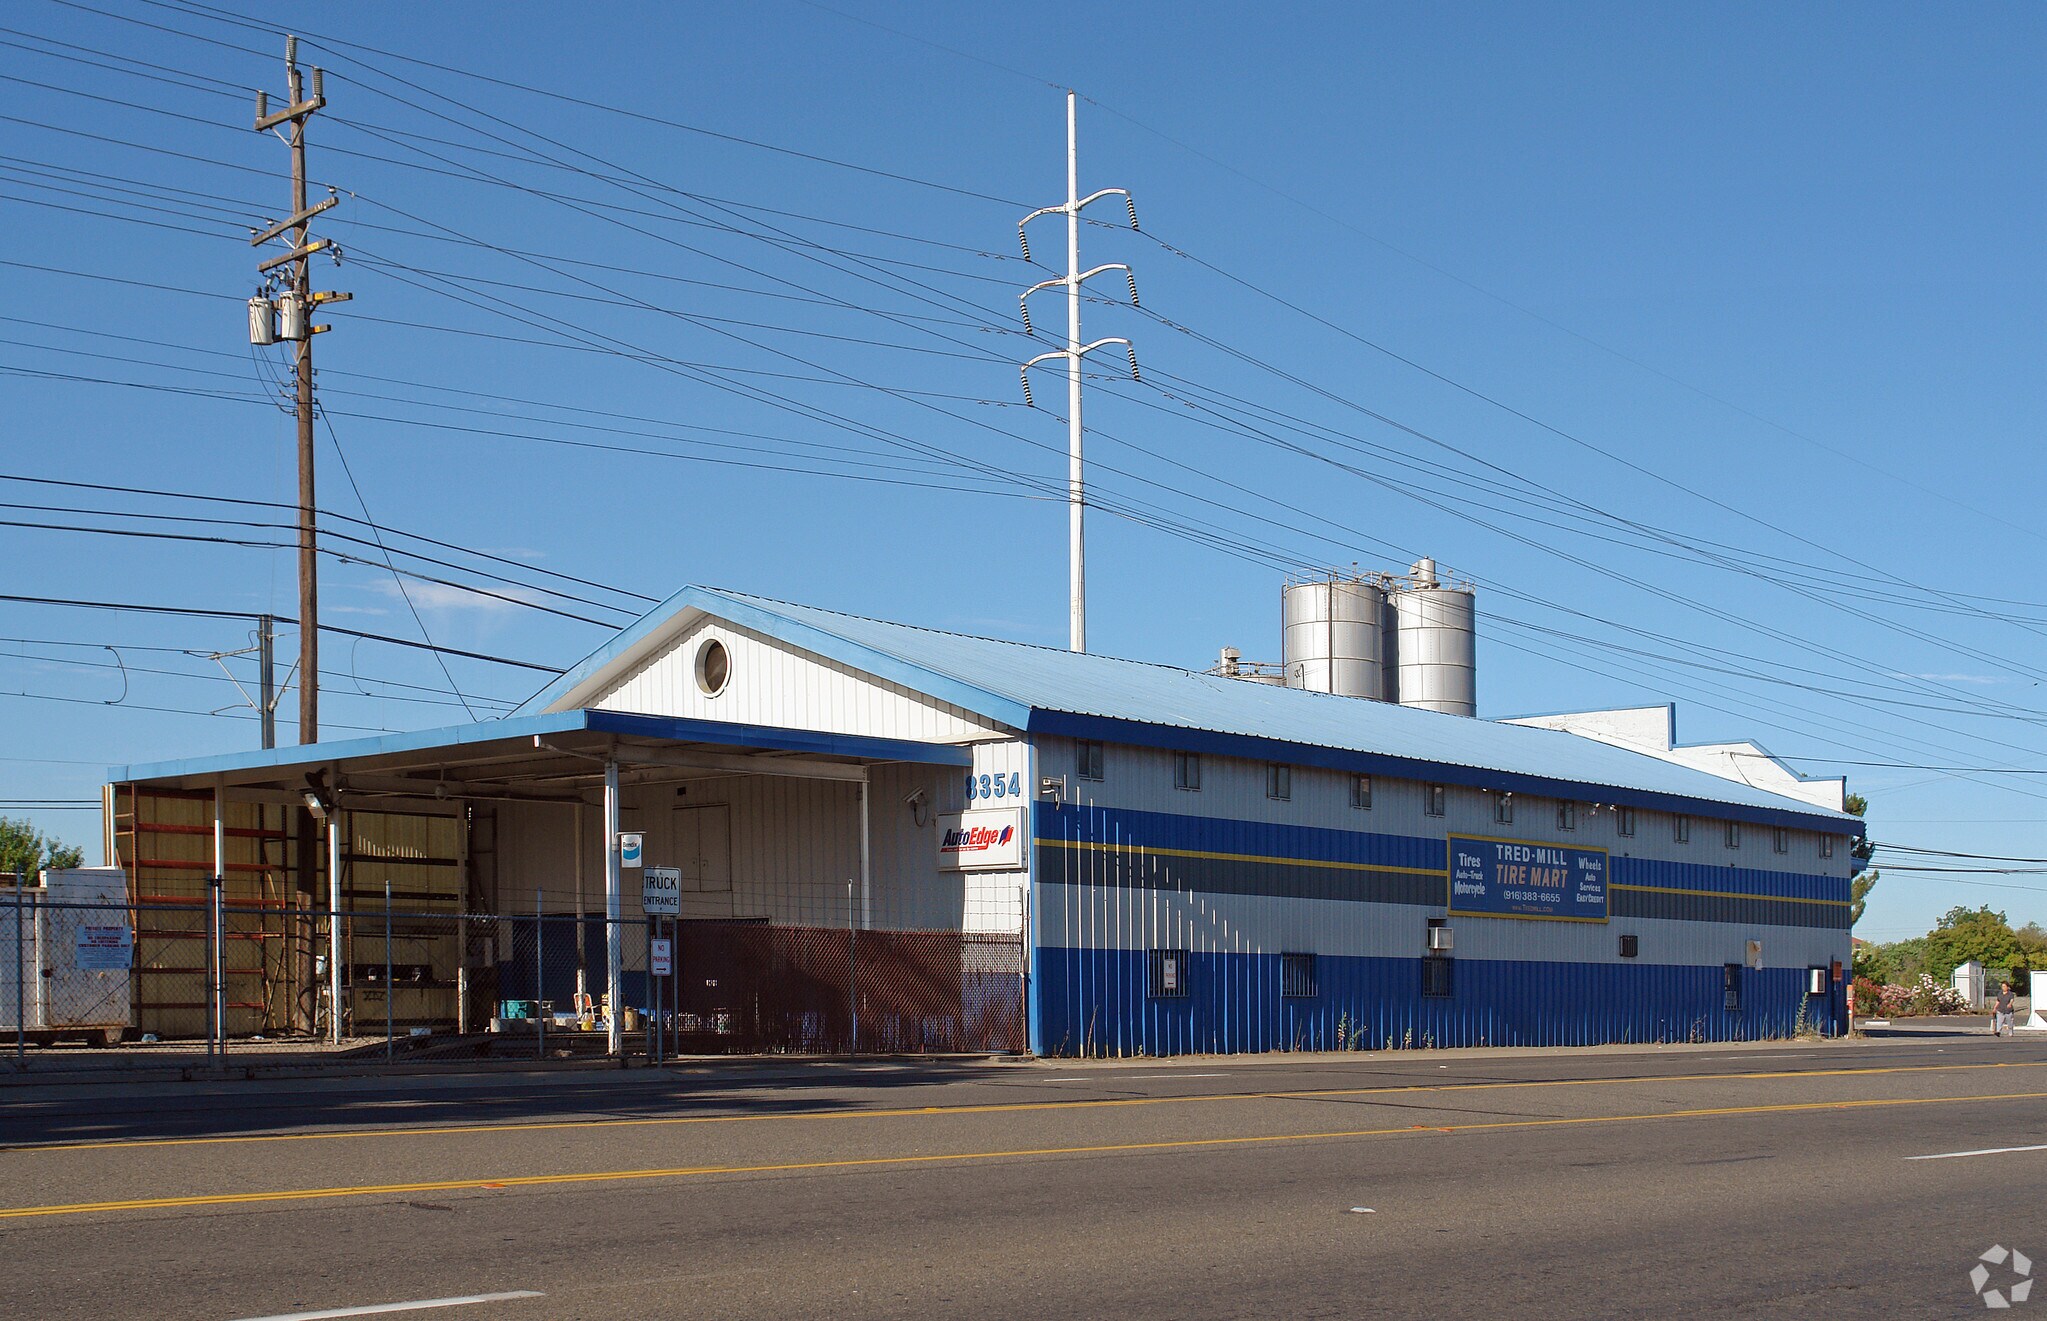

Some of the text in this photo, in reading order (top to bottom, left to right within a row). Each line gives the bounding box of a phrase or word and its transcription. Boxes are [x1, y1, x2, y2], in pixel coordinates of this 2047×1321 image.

[966, 772, 1020, 800] 8354
[942, 827, 999, 847] AutoEdge
[1458, 852, 1481, 868] Tires
[1578, 857, 1602, 871] Wheels
[645, 876, 677, 890] TRUCK
[1496, 864, 1568, 888] TIRE MART
[1585, 872, 1596, 882] Auto
[1454, 880, 1486, 898] Motorcycle
[1579, 882, 1601, 893] Services
[643, 896, 678, 906] ENTRANCE
[1503, 890, 1561, 903] (916)383-6655
